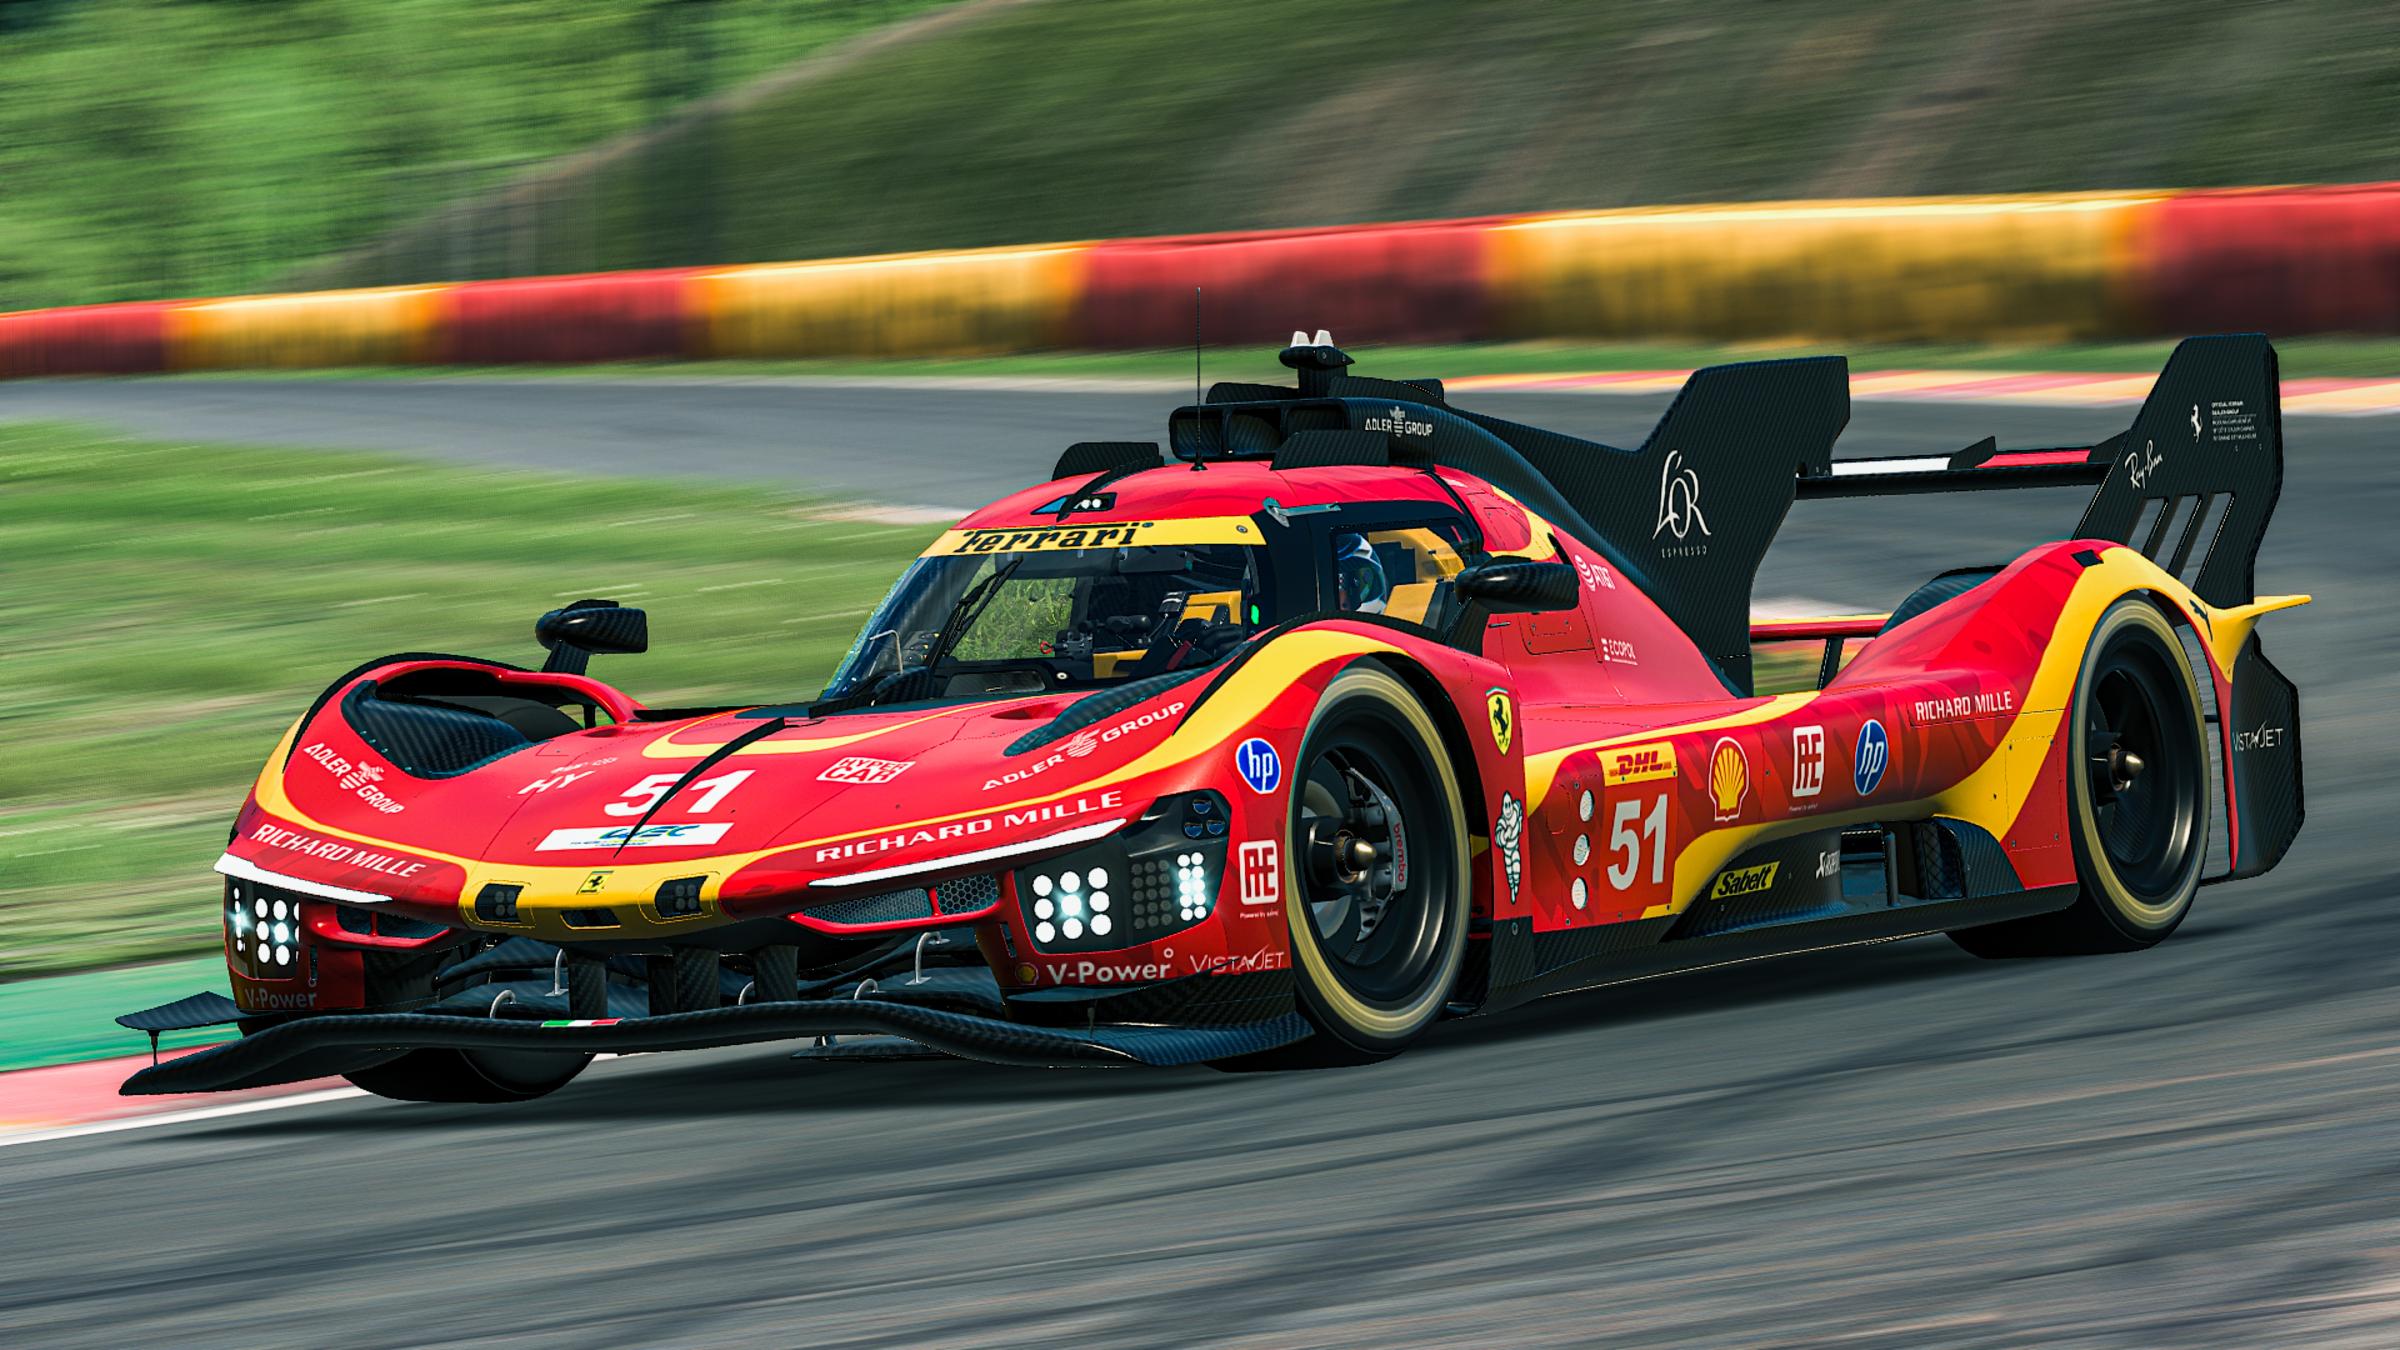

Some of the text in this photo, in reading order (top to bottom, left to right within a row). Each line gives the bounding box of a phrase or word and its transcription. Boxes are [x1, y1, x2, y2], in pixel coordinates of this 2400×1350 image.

[1365, 418, 1433, 437] ADLER GROUP
[952, 522, 1140, 553] Ferrari
[1661, 545, 1707, 559] ESPRESSO
[1609, 639, 1636, 659] ECOPOL
[1915, 691, 2012, 721] RICHARD MILLE
[982, 702, 1185, 790] ADLER GROUP
[1856, 723, 1885, 793] hp
[304, 743, 405, 814] ADLER GROUP
[825, 767, 896, 782] CAR
[1616, 750, 1664, 776] DHL
[604, 770, 757, 817] 51
[816, 790, 1123, 863] RICHARD MILLE
[251, 824, 427, 878] RICHARD MILLE
[1394, 822, 1406, 882] brembo
[1607, 794, 1668, 891] 51
[1718, 865, 1773, 896] Sabelt
[1047, 961, 1170, 984] V-Power
[245, 988, 317, 1009] V-Power
